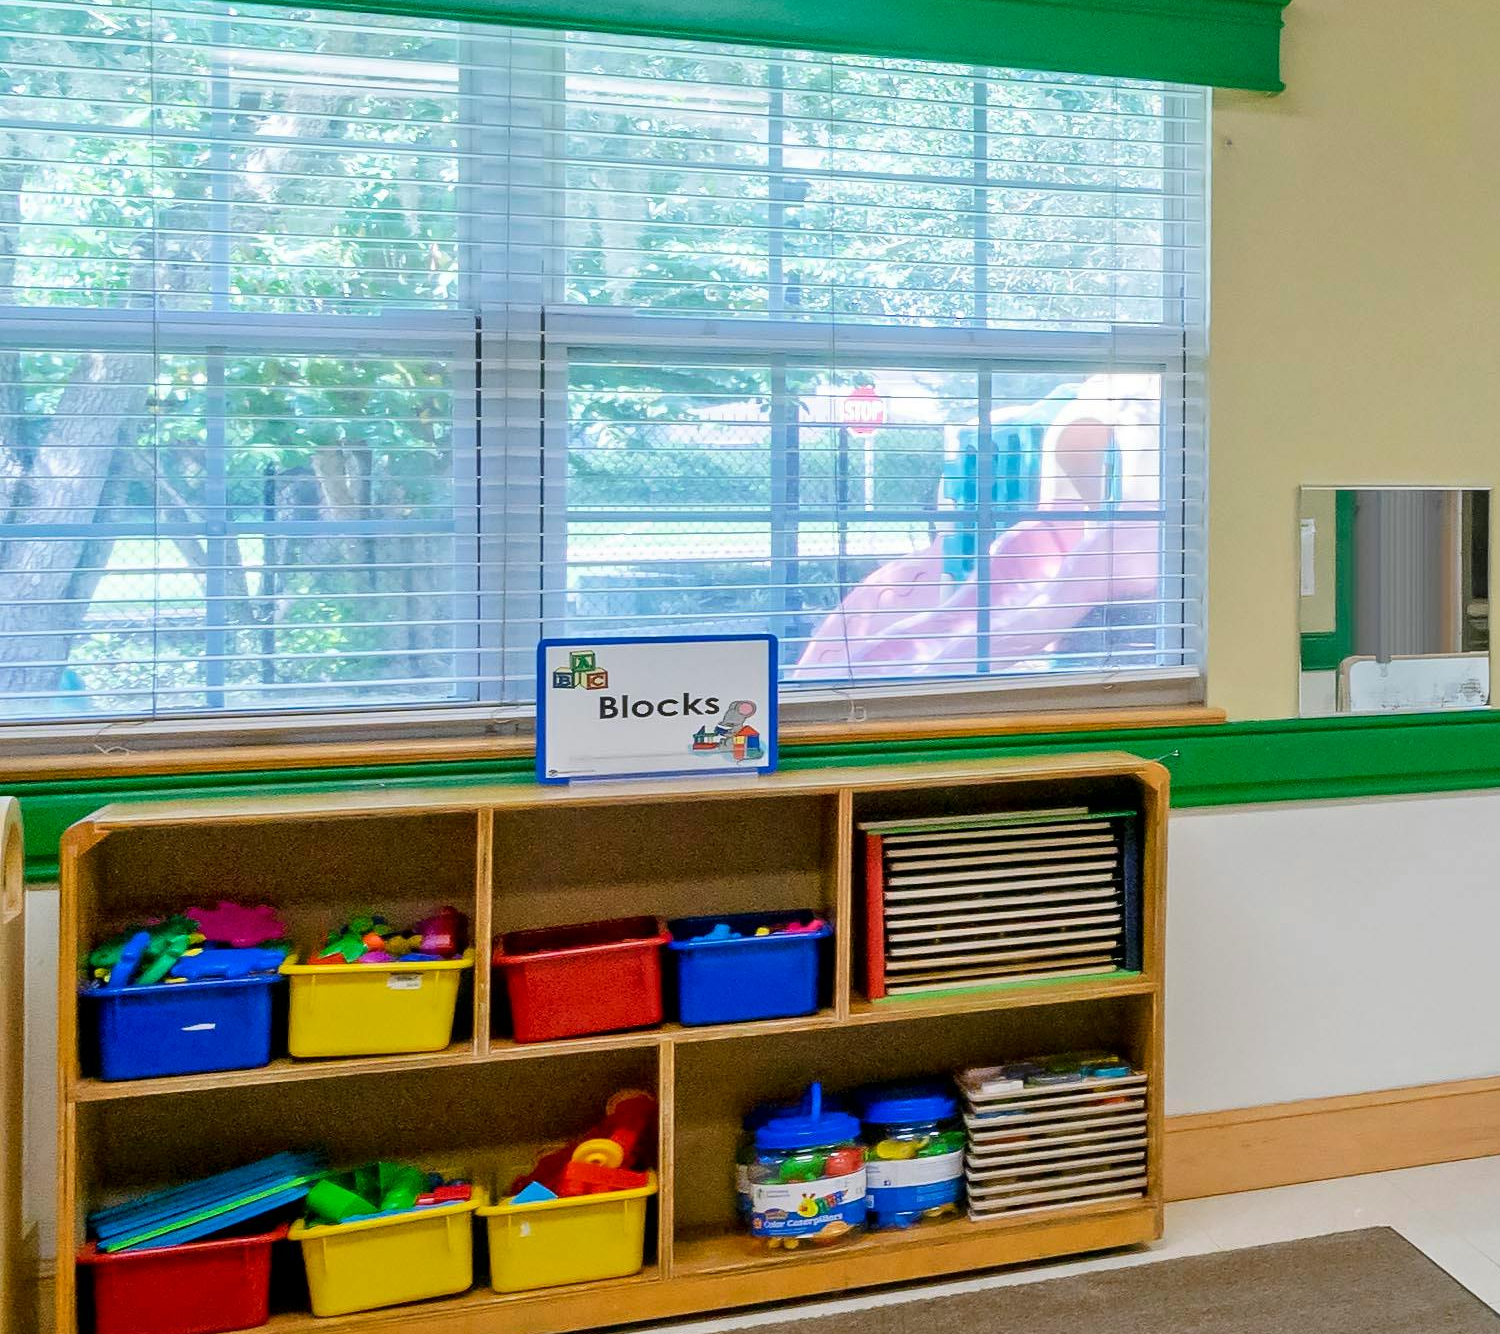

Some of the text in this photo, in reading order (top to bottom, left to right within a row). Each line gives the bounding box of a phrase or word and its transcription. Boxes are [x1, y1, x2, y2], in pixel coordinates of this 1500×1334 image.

[599, 692, 720, 720] Blocks
[763, 1212, 844, 1229] Color Caterpillars
